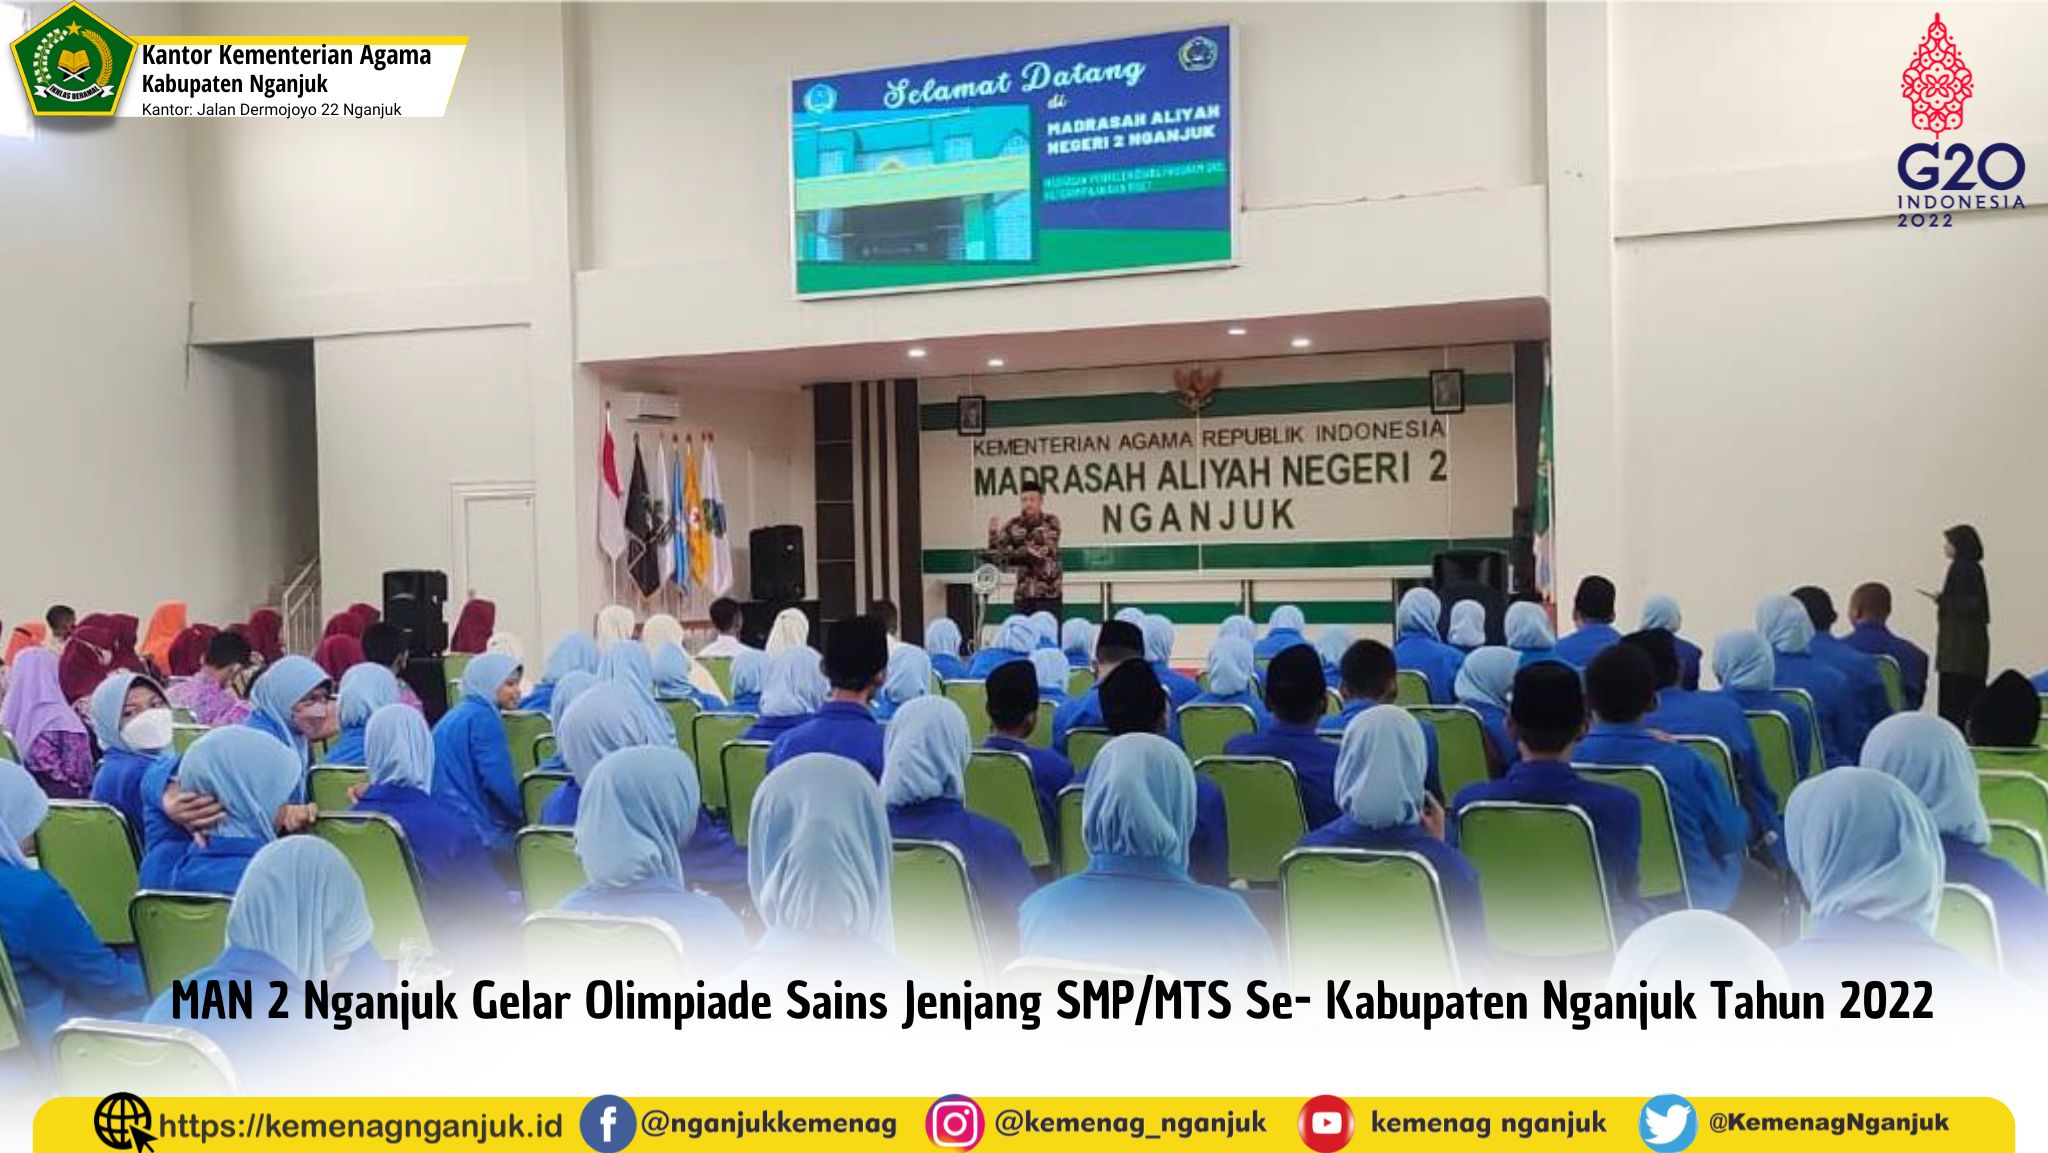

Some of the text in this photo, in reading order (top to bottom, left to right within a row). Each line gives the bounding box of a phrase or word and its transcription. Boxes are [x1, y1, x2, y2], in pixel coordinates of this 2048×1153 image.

[883, 61, 1146, 109] Selamat Datang
[1048, 93, 1068, 110] di
[1048, 115, 1147, 137] MADRASAH
[1048, 124, 1216, 155] NEGERI 2 NGANJUK
[973, 418, 1446, 457] KEMENTERIAN AGAMA REPUBLIK INDONESIA
[974, 449, 1448, 497] MADRASAH ALIYAH NEGERI 2
[1102, 498, 1295, 534] NGANJUK
